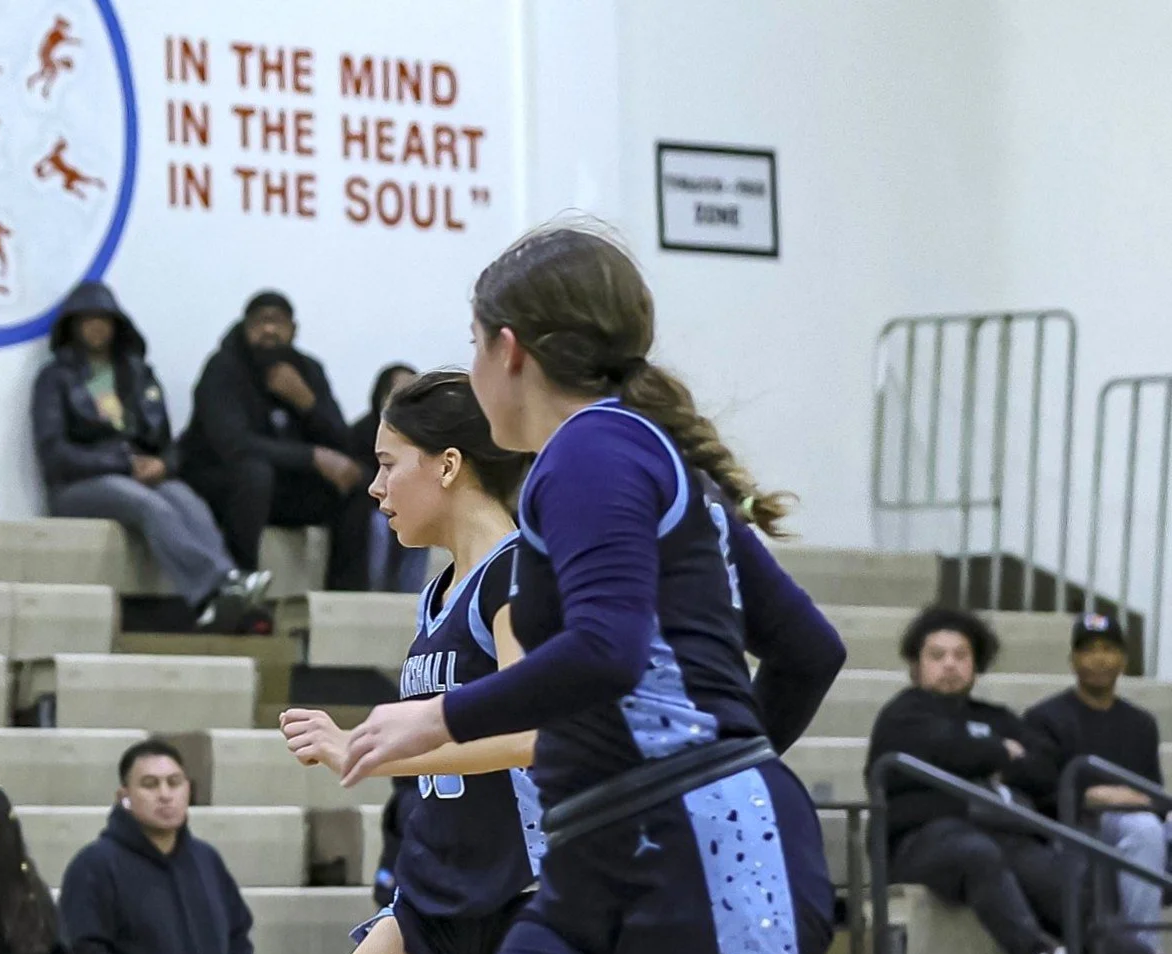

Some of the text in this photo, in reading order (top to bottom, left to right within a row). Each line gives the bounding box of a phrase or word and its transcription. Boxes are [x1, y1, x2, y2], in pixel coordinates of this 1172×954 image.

[164, 35, 459, 107] IN THE MIND
[167, 99, 485, 172] IN THE HEART
[168, 162, 212, 209] IN
[233, 168, 317, 218] THE
